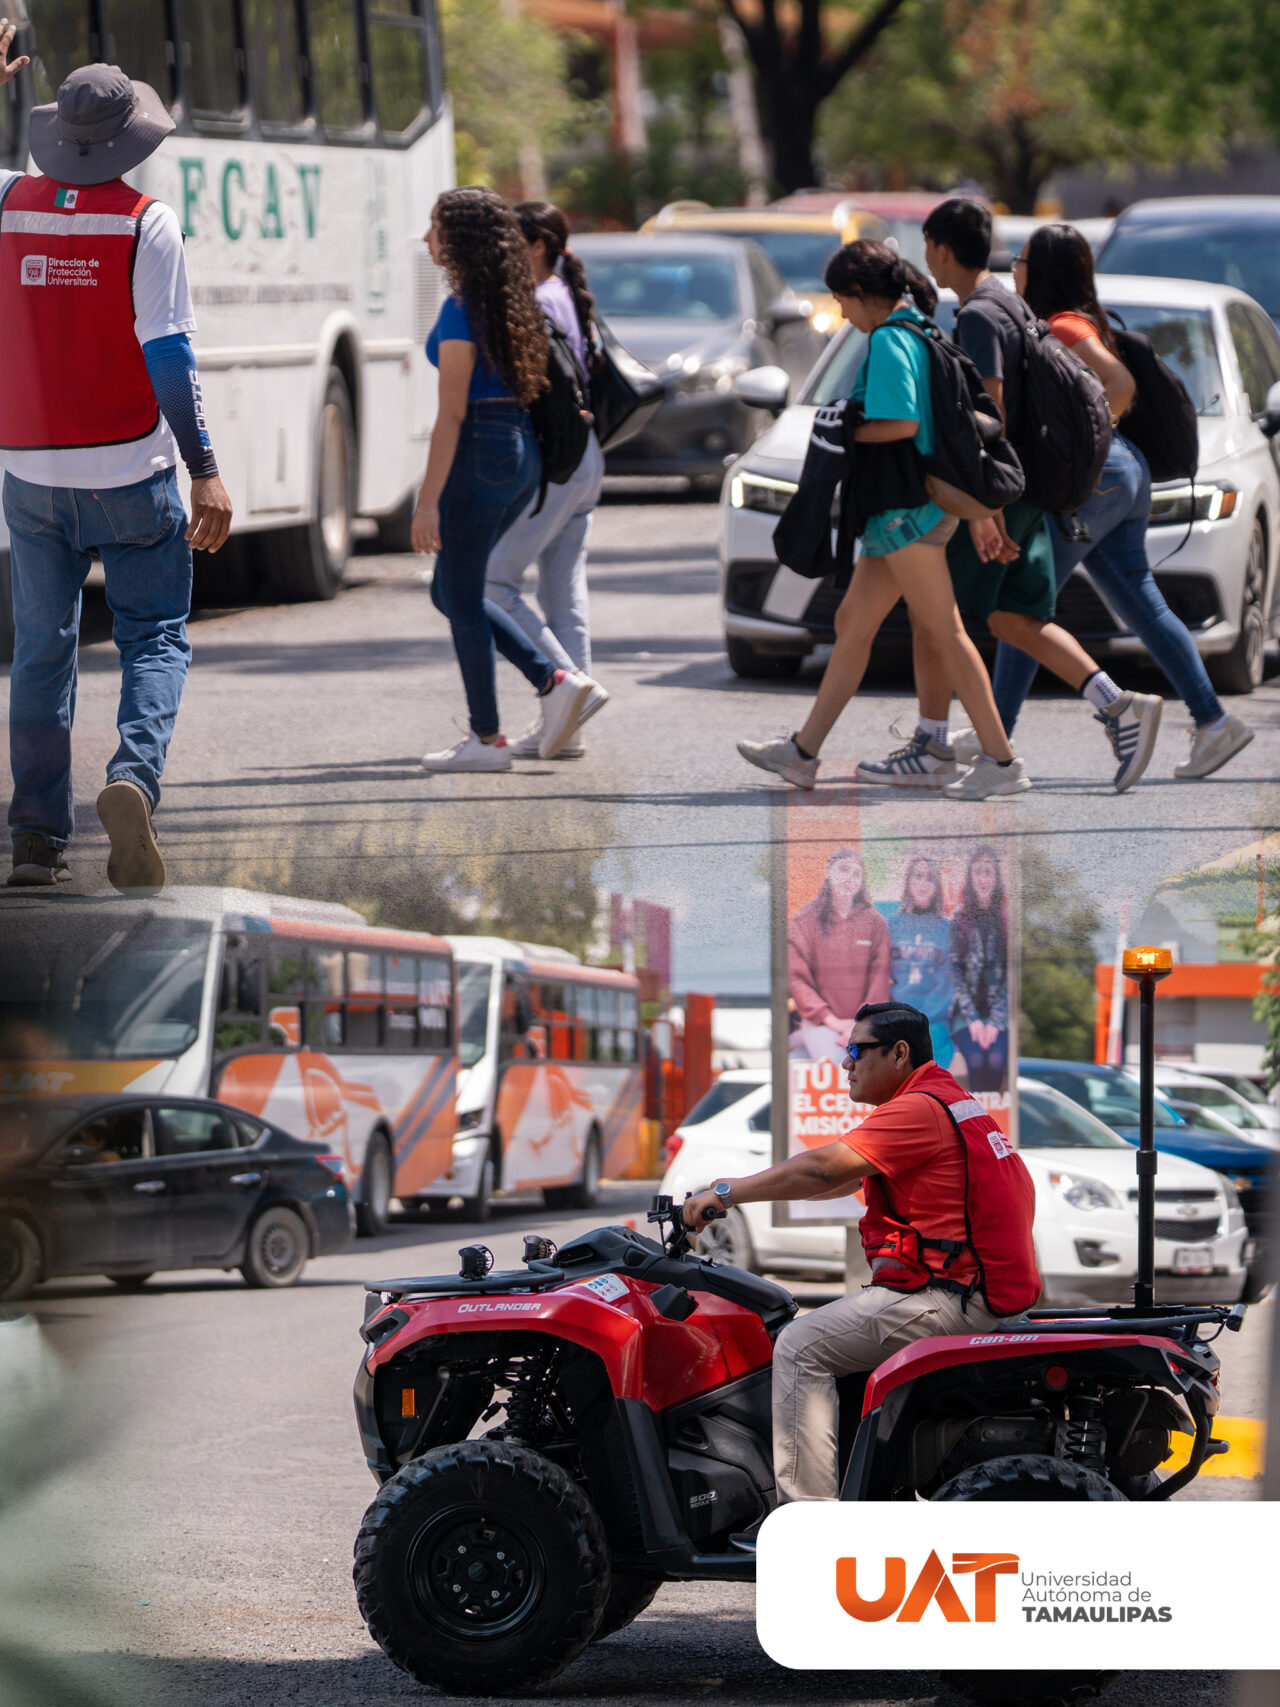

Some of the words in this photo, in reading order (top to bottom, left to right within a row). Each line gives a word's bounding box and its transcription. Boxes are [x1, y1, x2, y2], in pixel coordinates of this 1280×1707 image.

[88, 258, 99, 267] de
[48, 267, 91, 277] Protección
[47, 276, 98, 287] Universitaria
[792, 1093, 817, 1112] EL
[458, 1303, 541, 1313] OUTLANDER
